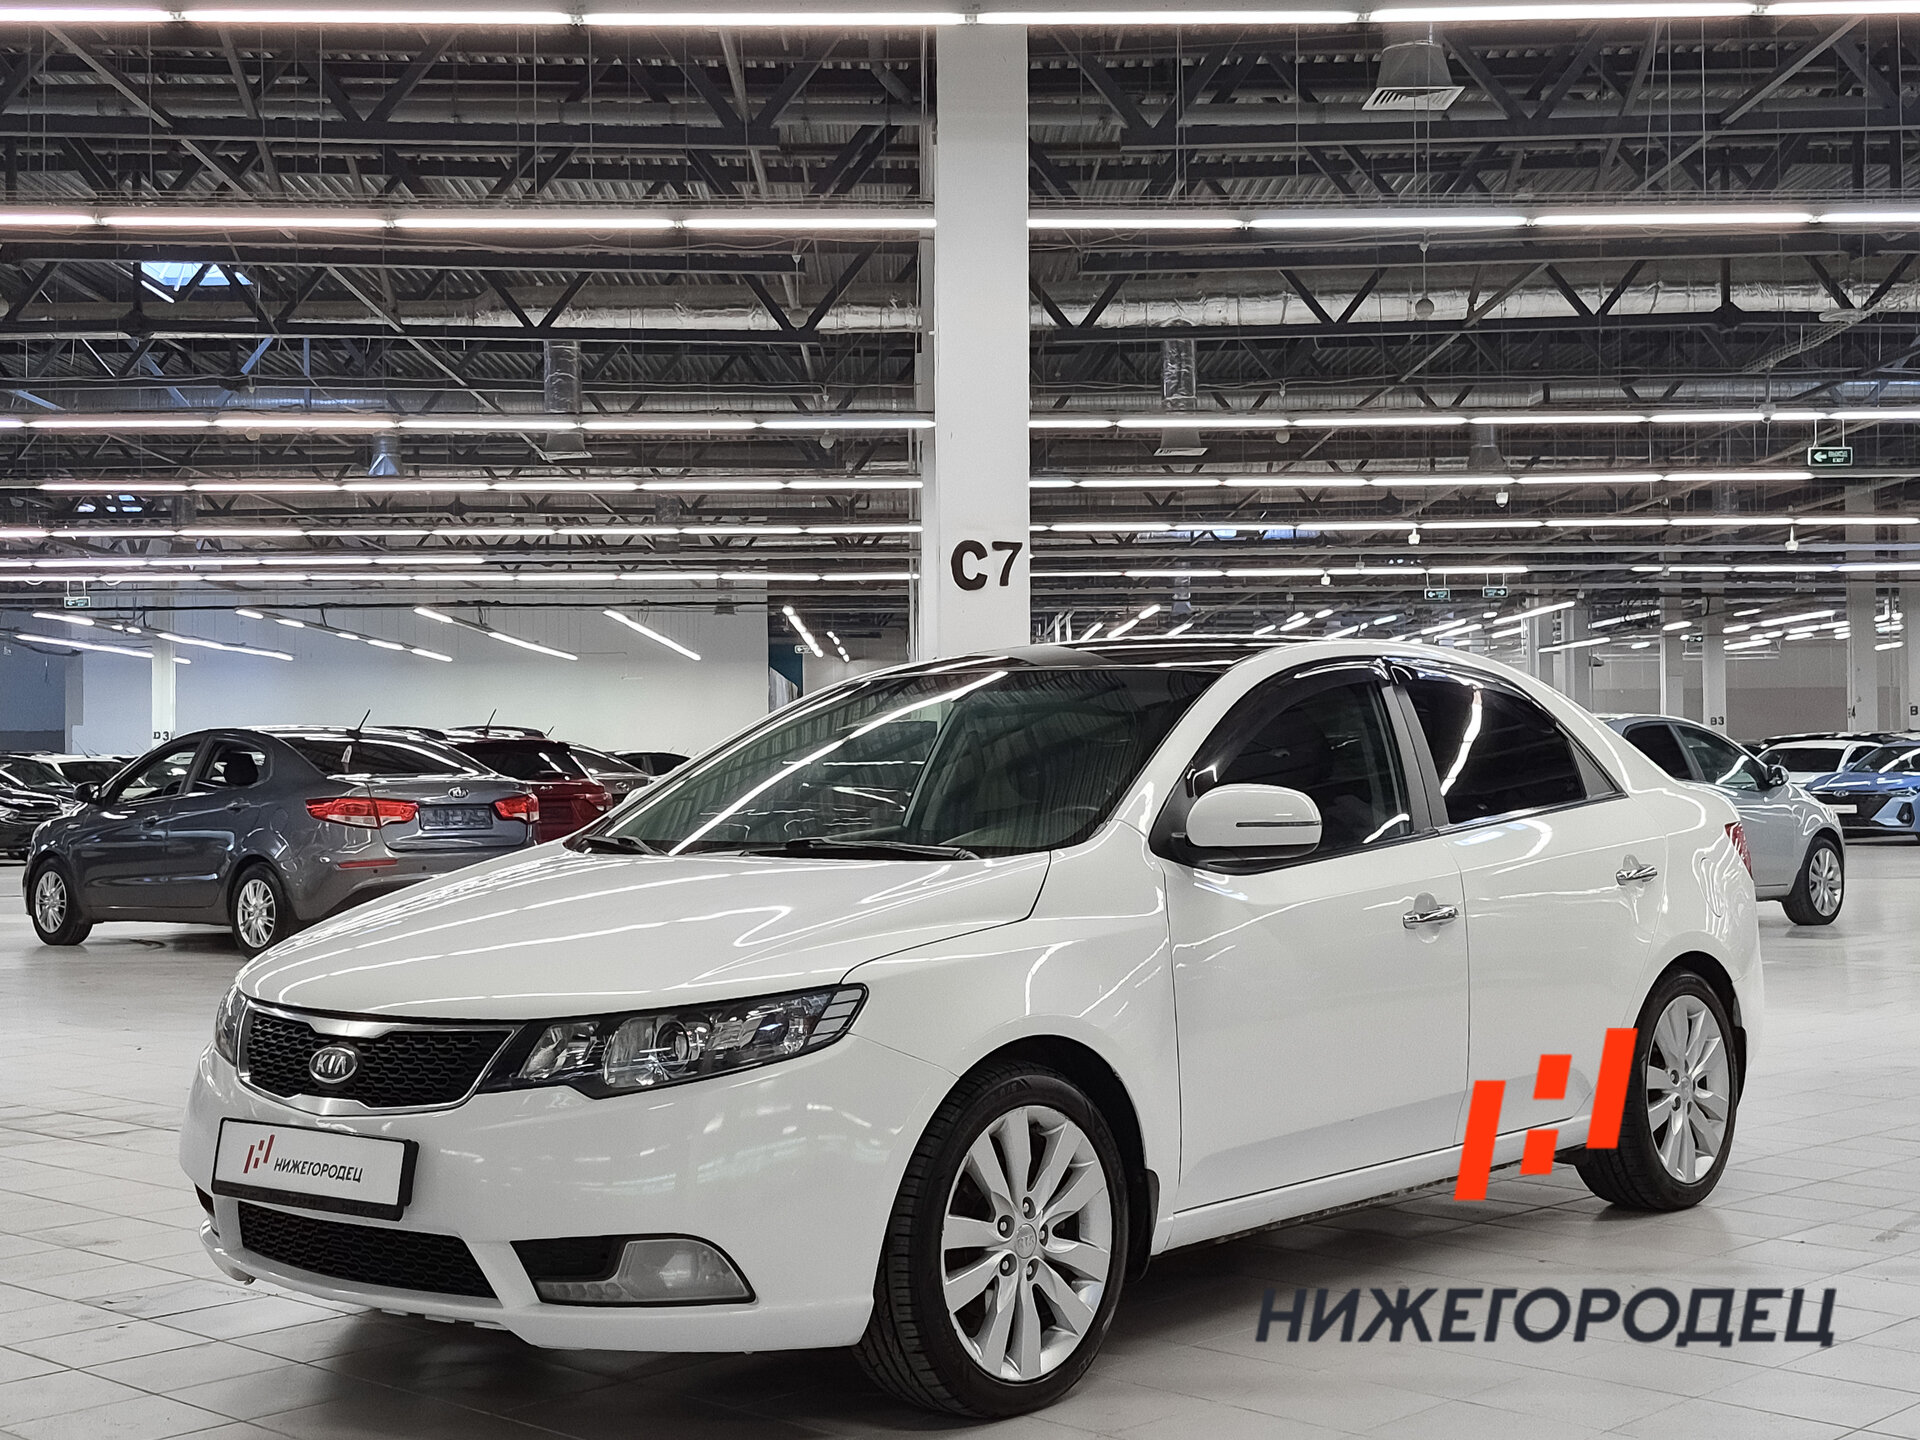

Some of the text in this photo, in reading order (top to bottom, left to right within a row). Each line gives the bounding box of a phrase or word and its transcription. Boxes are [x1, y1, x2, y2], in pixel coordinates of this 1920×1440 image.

[951, 540, 1023, 591] C7
[1710, 716, 1725, 726] B3
[153, 731, 170, 741] D3
[316, 1054, 348, 1075] KIA
[273, 1157, 364, 1183] НИЖЕГОРОДЕЦ
